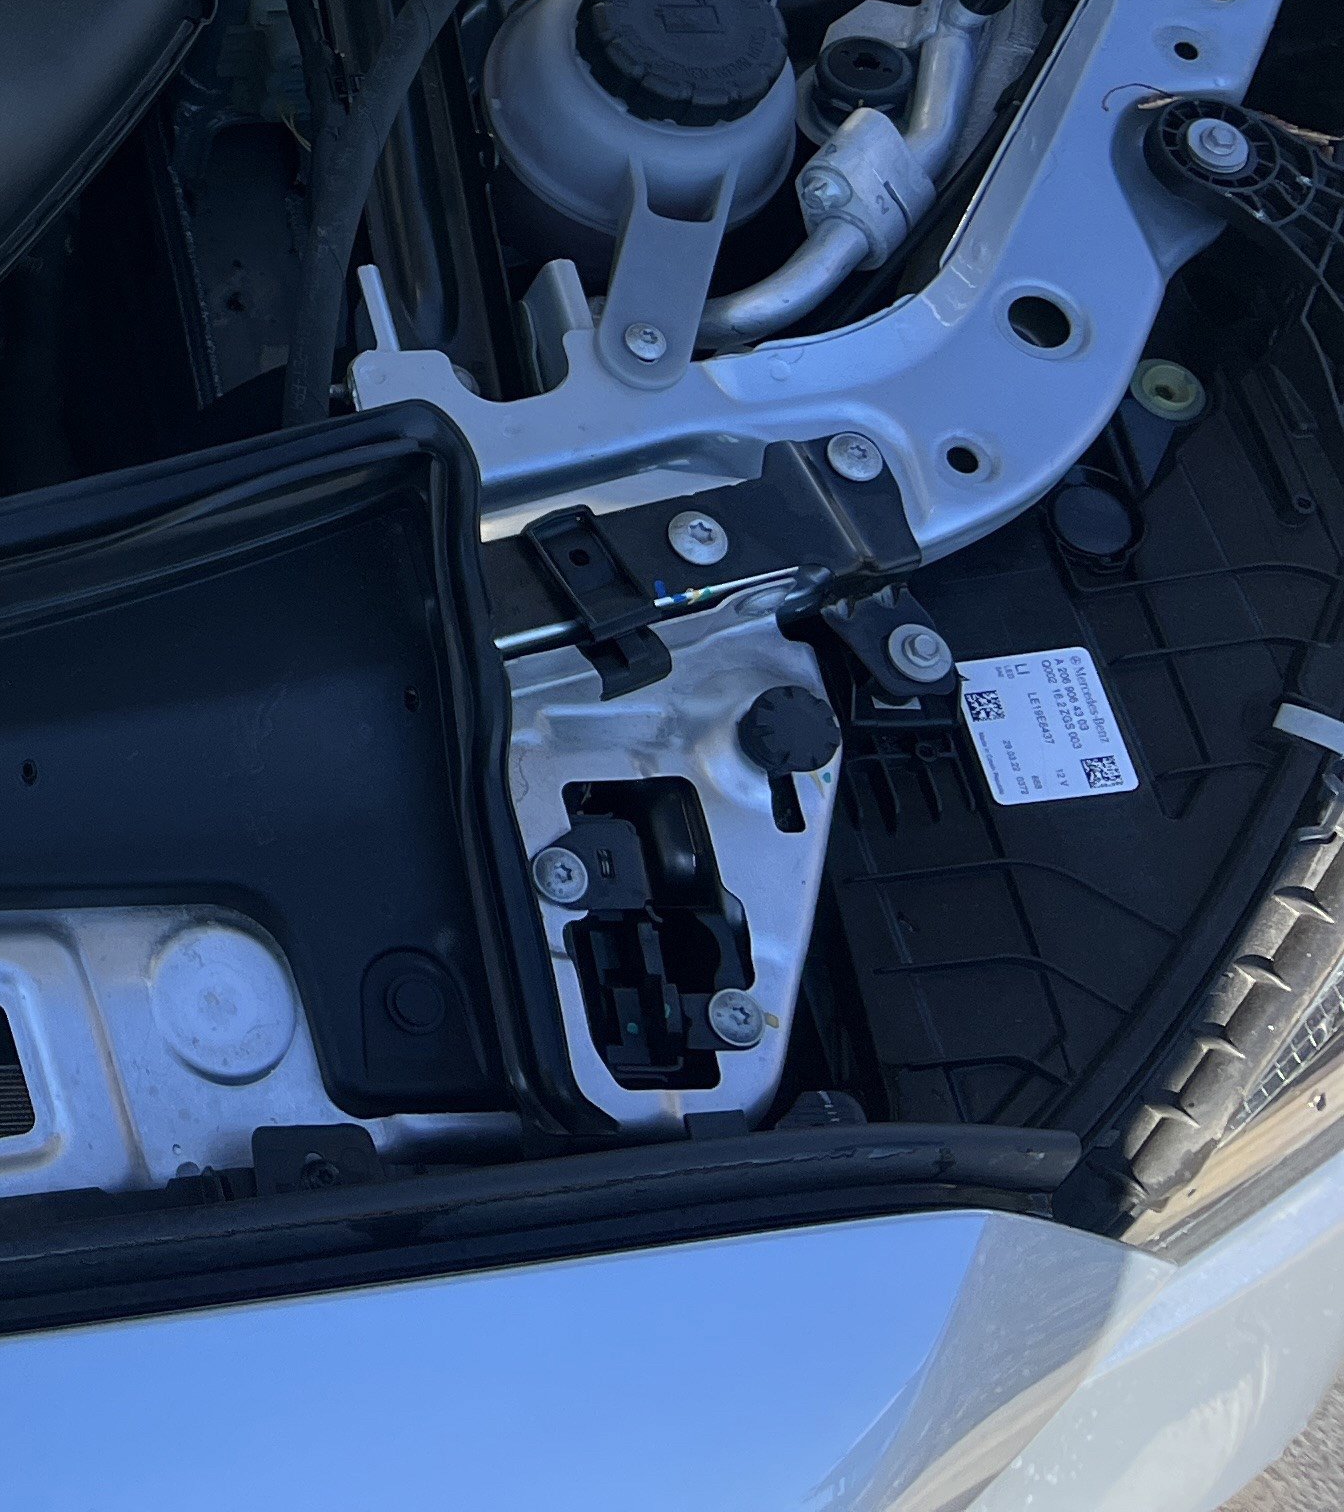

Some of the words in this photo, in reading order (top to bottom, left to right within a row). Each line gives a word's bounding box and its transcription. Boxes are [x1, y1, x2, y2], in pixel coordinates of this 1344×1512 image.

[1055, 657, 1064, 665] A
[1058, 666, 1071, 684] 206
[1075, 666, 1110, 743] Mercedes-Benz
